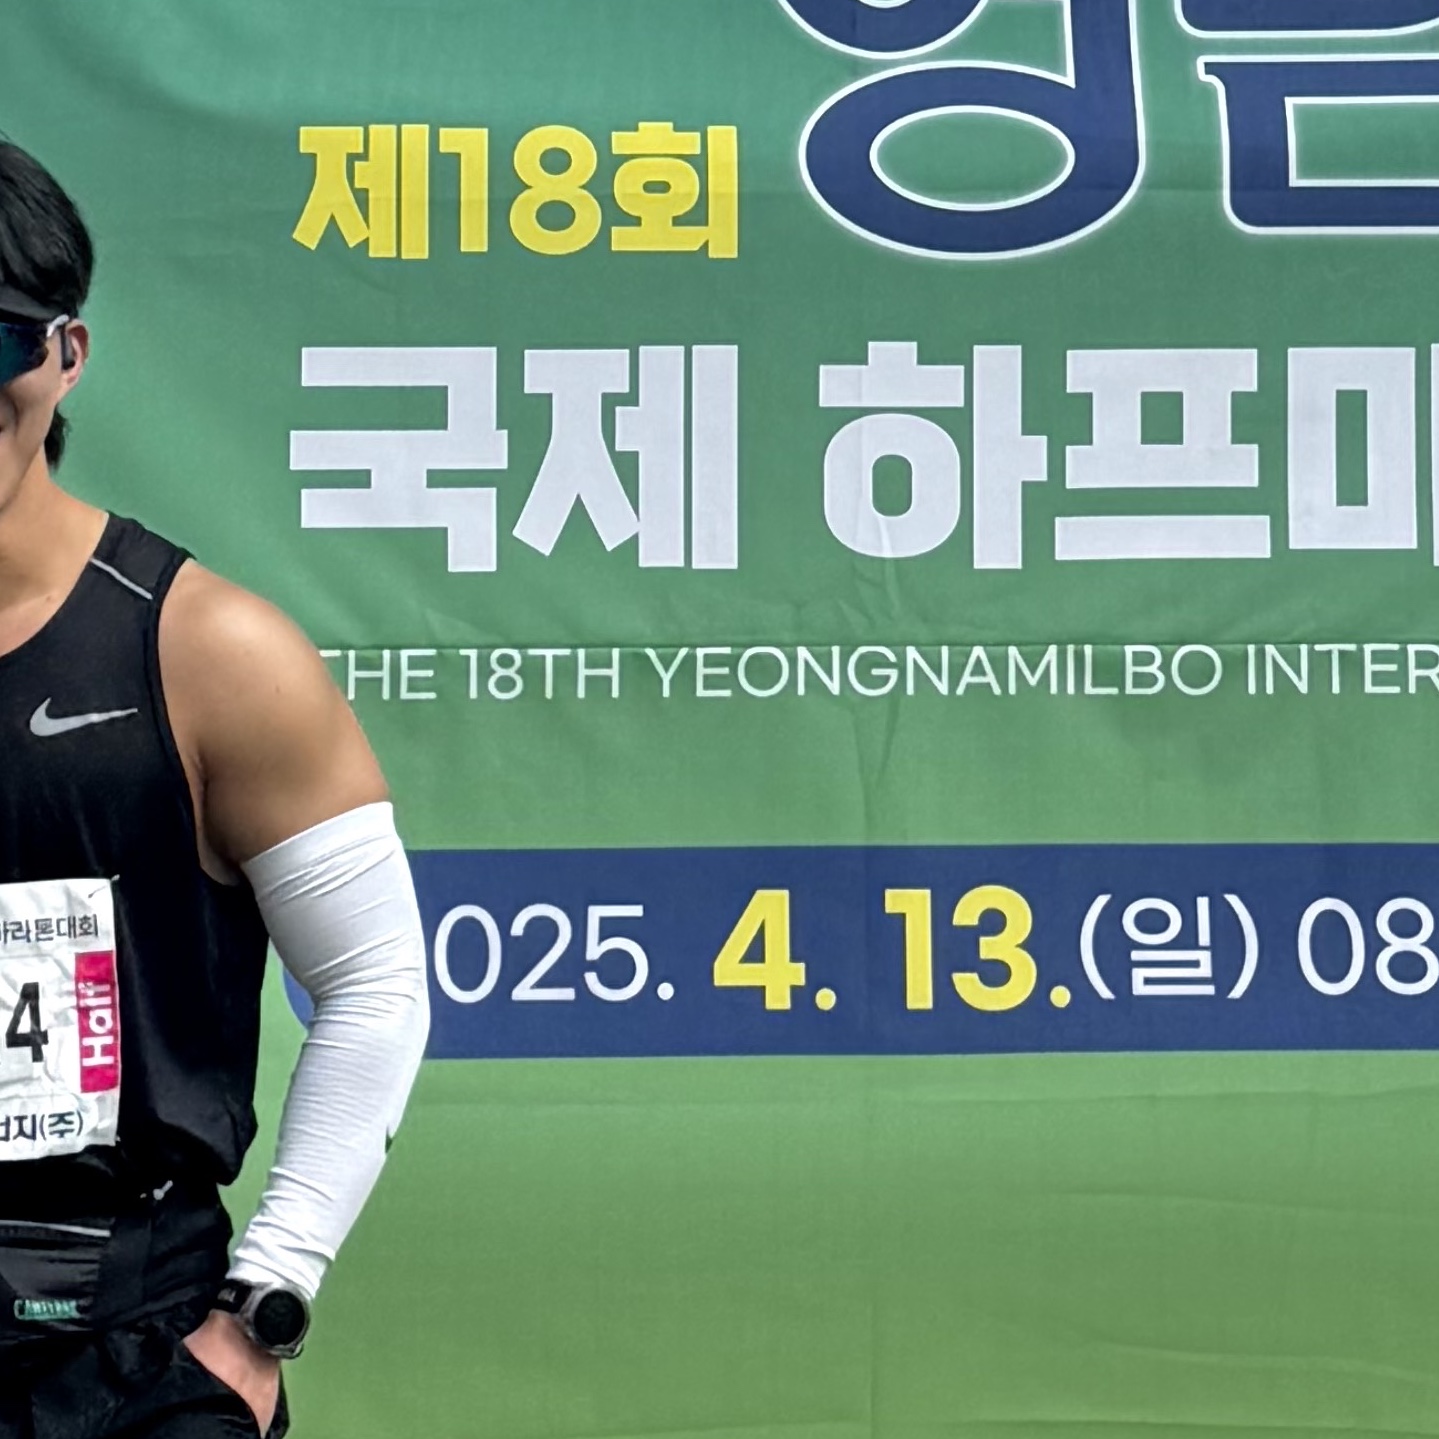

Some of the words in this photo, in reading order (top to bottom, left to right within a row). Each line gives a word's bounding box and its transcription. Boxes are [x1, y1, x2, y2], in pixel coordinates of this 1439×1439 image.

[293, 121, 738, 259] 제18회
[289, 345, 738, 572] 국제
[461, 647, 620, 700] 18TH
[645, 644, 1221, 698] YEONGNAMILBO
[1246, 643, 1439, 696] INTER
[433, 903, 673, 1003] 025.
[712, 888, 836, 1011] 4.
[78, 979, 116, 1067] Half
